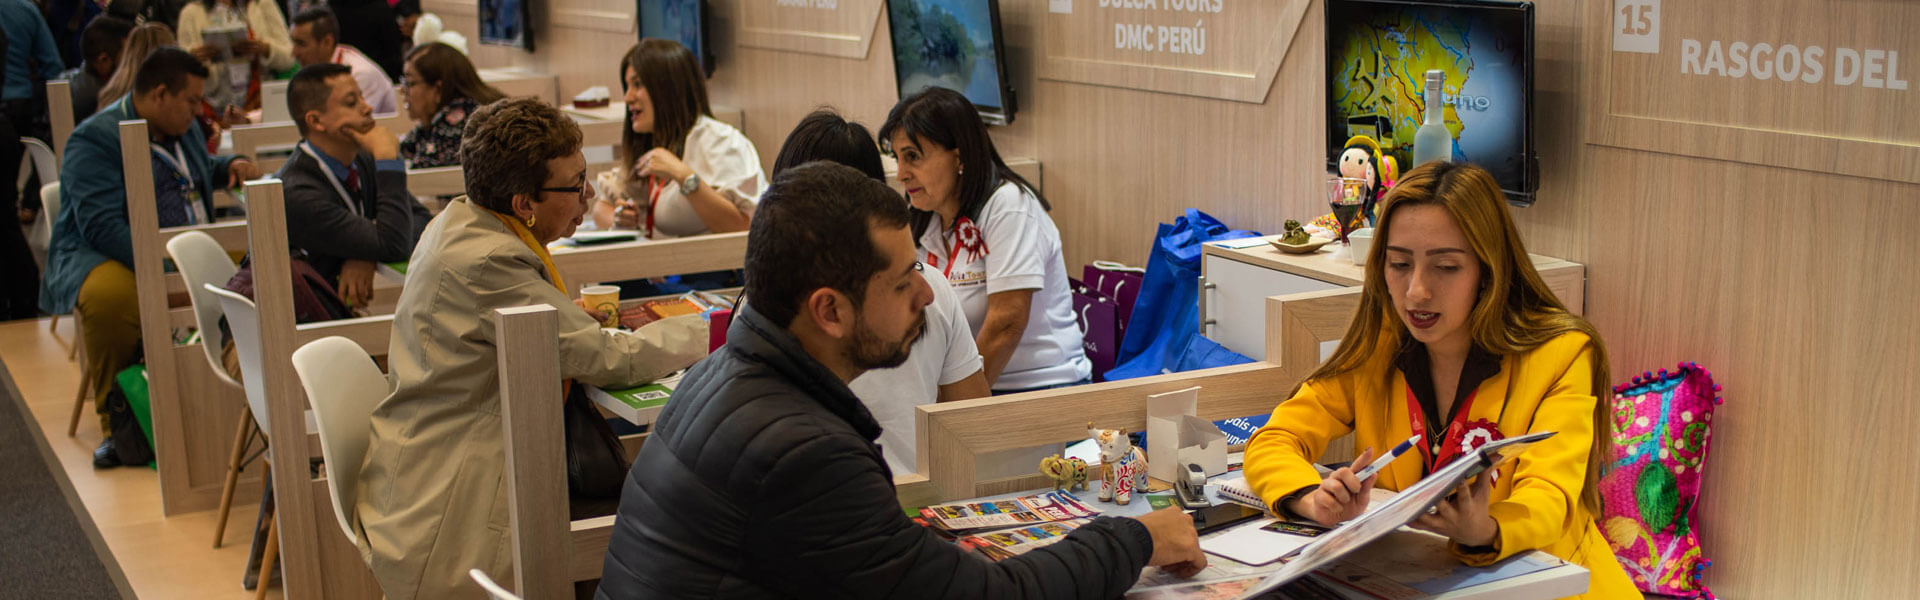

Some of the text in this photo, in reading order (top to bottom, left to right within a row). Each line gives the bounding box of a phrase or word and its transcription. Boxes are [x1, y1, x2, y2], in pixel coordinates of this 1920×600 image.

[1115, 18, 1206, 55] DMC PERÚ
[1620, 4, 1652, 36] 15
[1680, 38, 1908, 90] RASGOS DEL
[1442, 93, 1490, 108] uno
